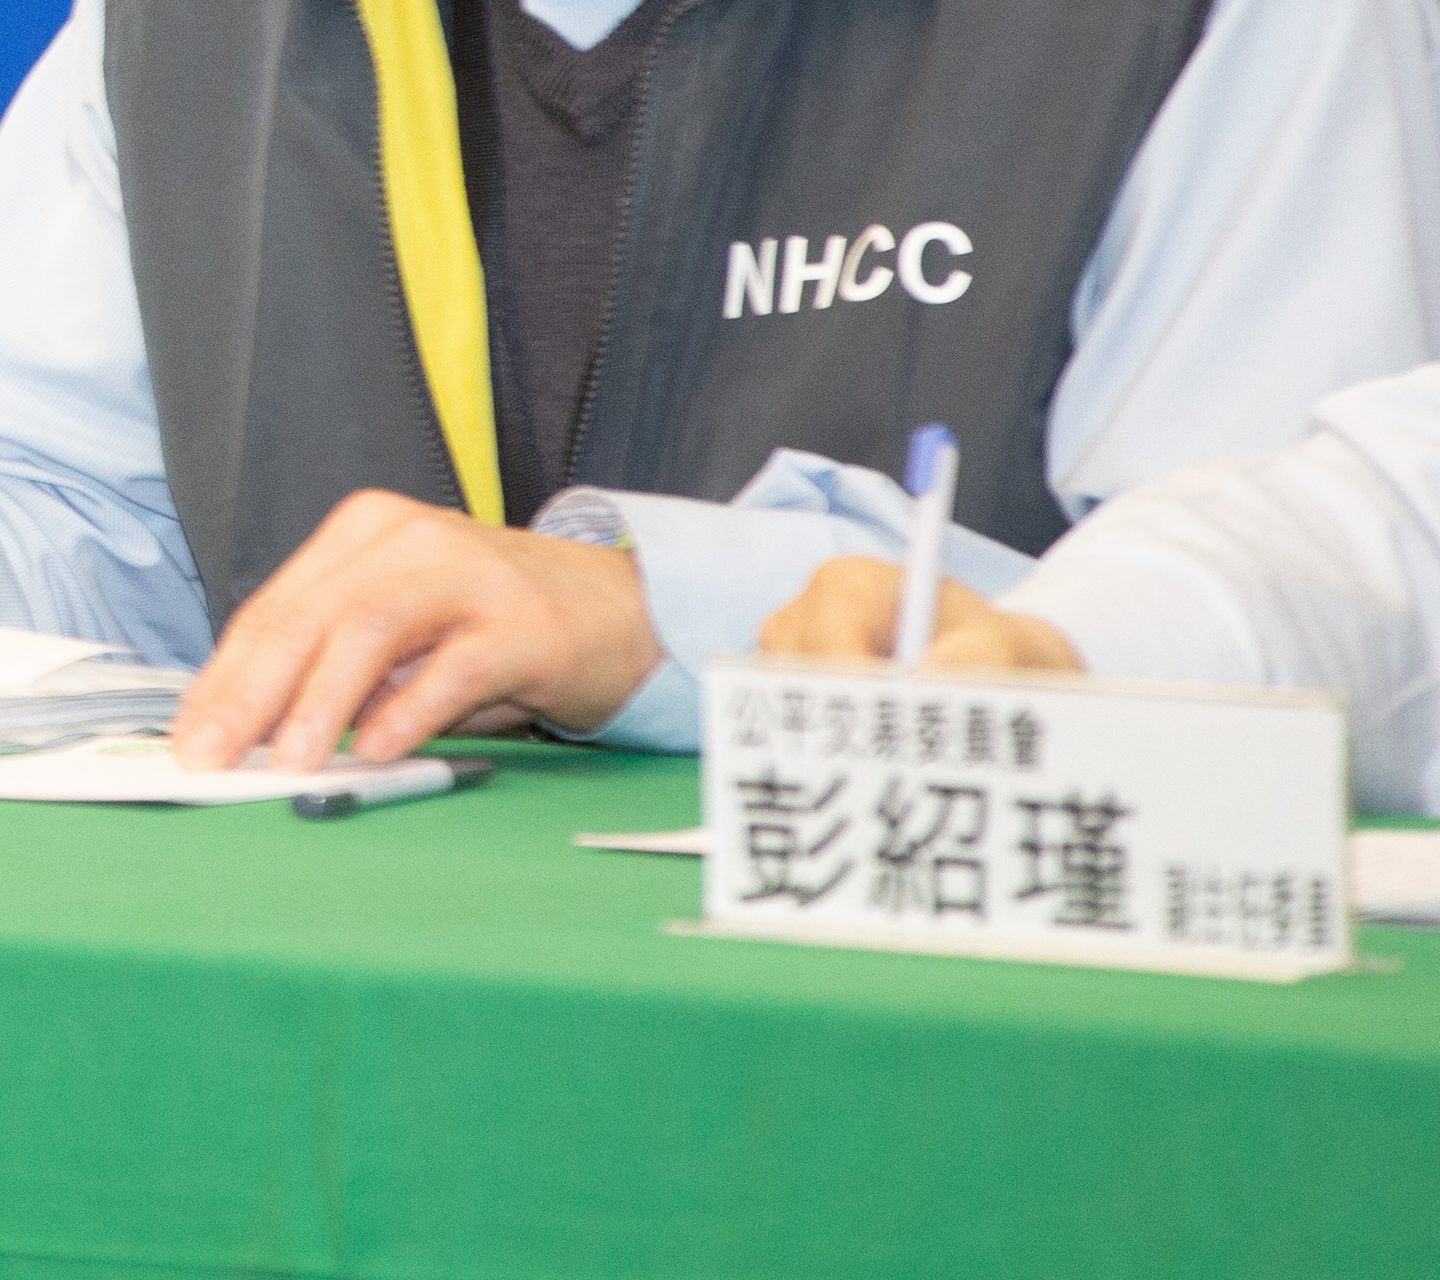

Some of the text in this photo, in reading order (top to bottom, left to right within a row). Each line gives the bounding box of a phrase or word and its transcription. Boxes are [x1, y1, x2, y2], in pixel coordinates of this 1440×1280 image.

[721, 220, 974, 320] NHCC
[734, 763, 1139, 935] 彭紹瑾
